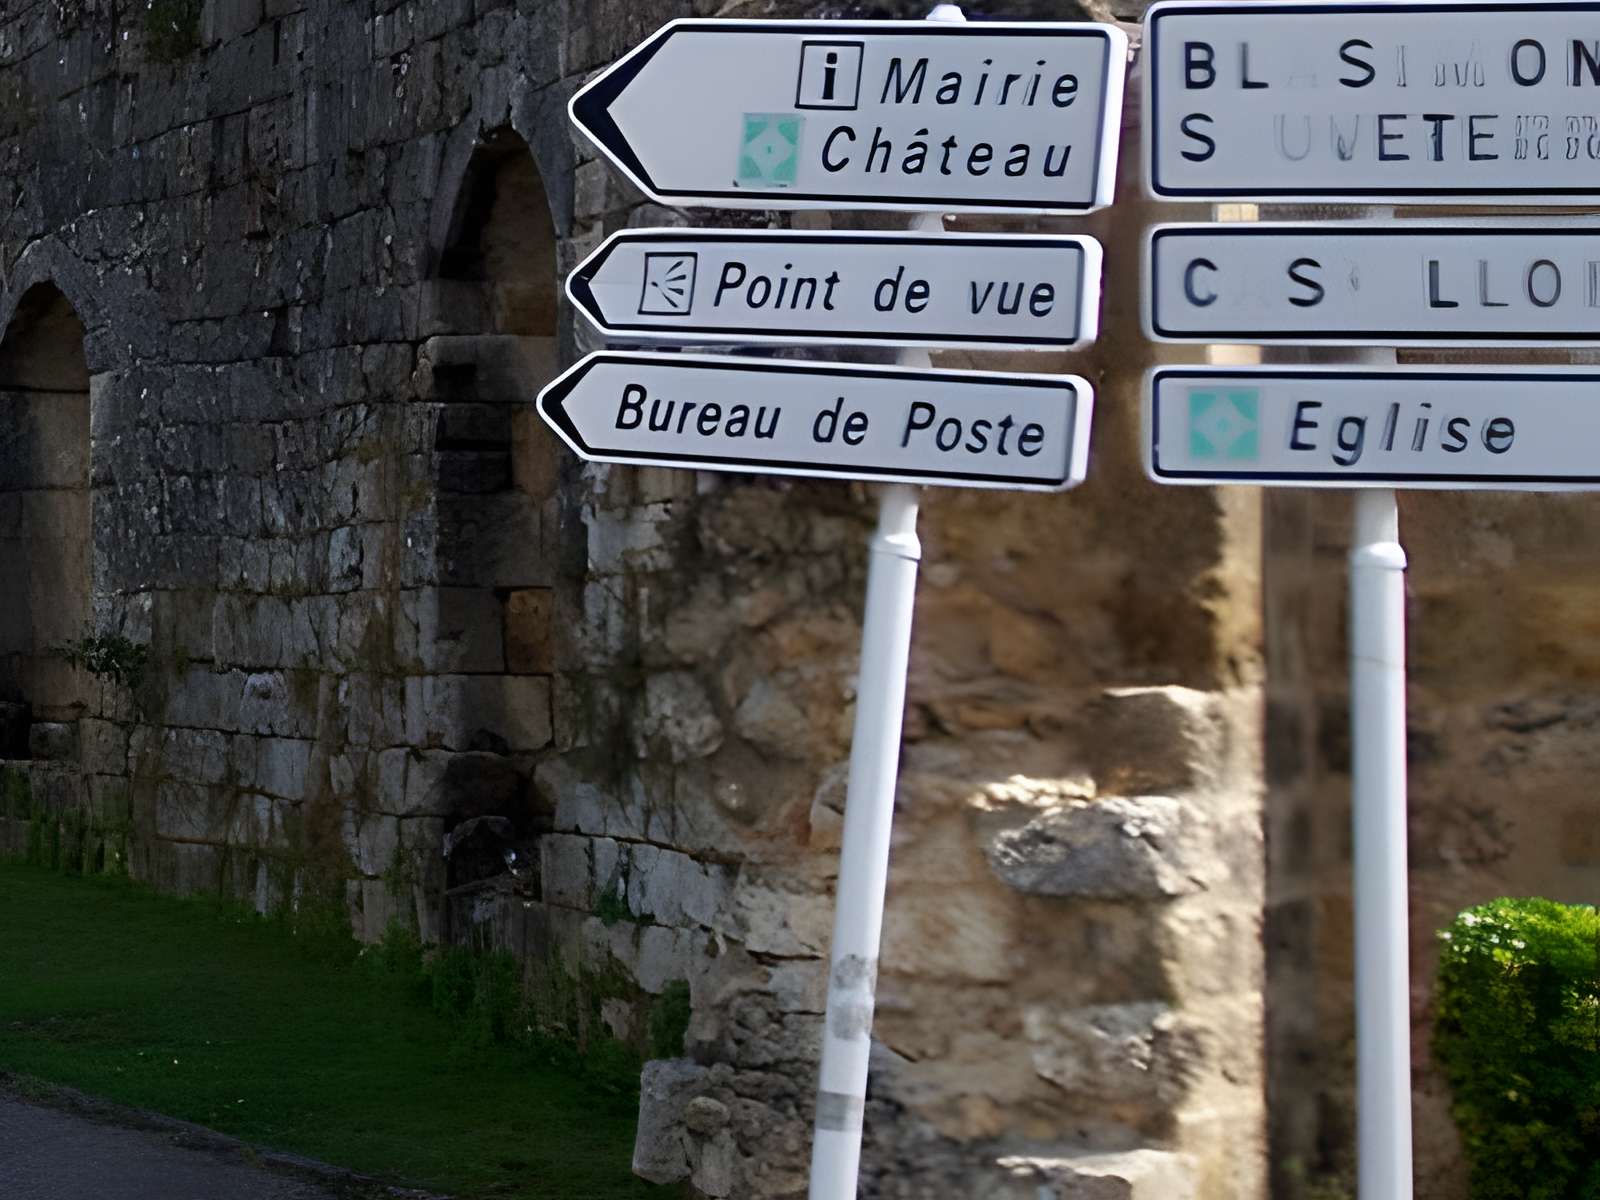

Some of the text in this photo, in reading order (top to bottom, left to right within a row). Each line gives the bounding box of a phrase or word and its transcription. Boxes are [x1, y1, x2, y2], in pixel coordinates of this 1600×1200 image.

[880, 57, 1078, 107] Mairie
[820, 125, 1072, 178] Château
[713, 261, 1056, 318] Point de vue
[615, 383, 1045, 457] Bureau de Poste
[1288, 400, 1516, 466] Eglise
